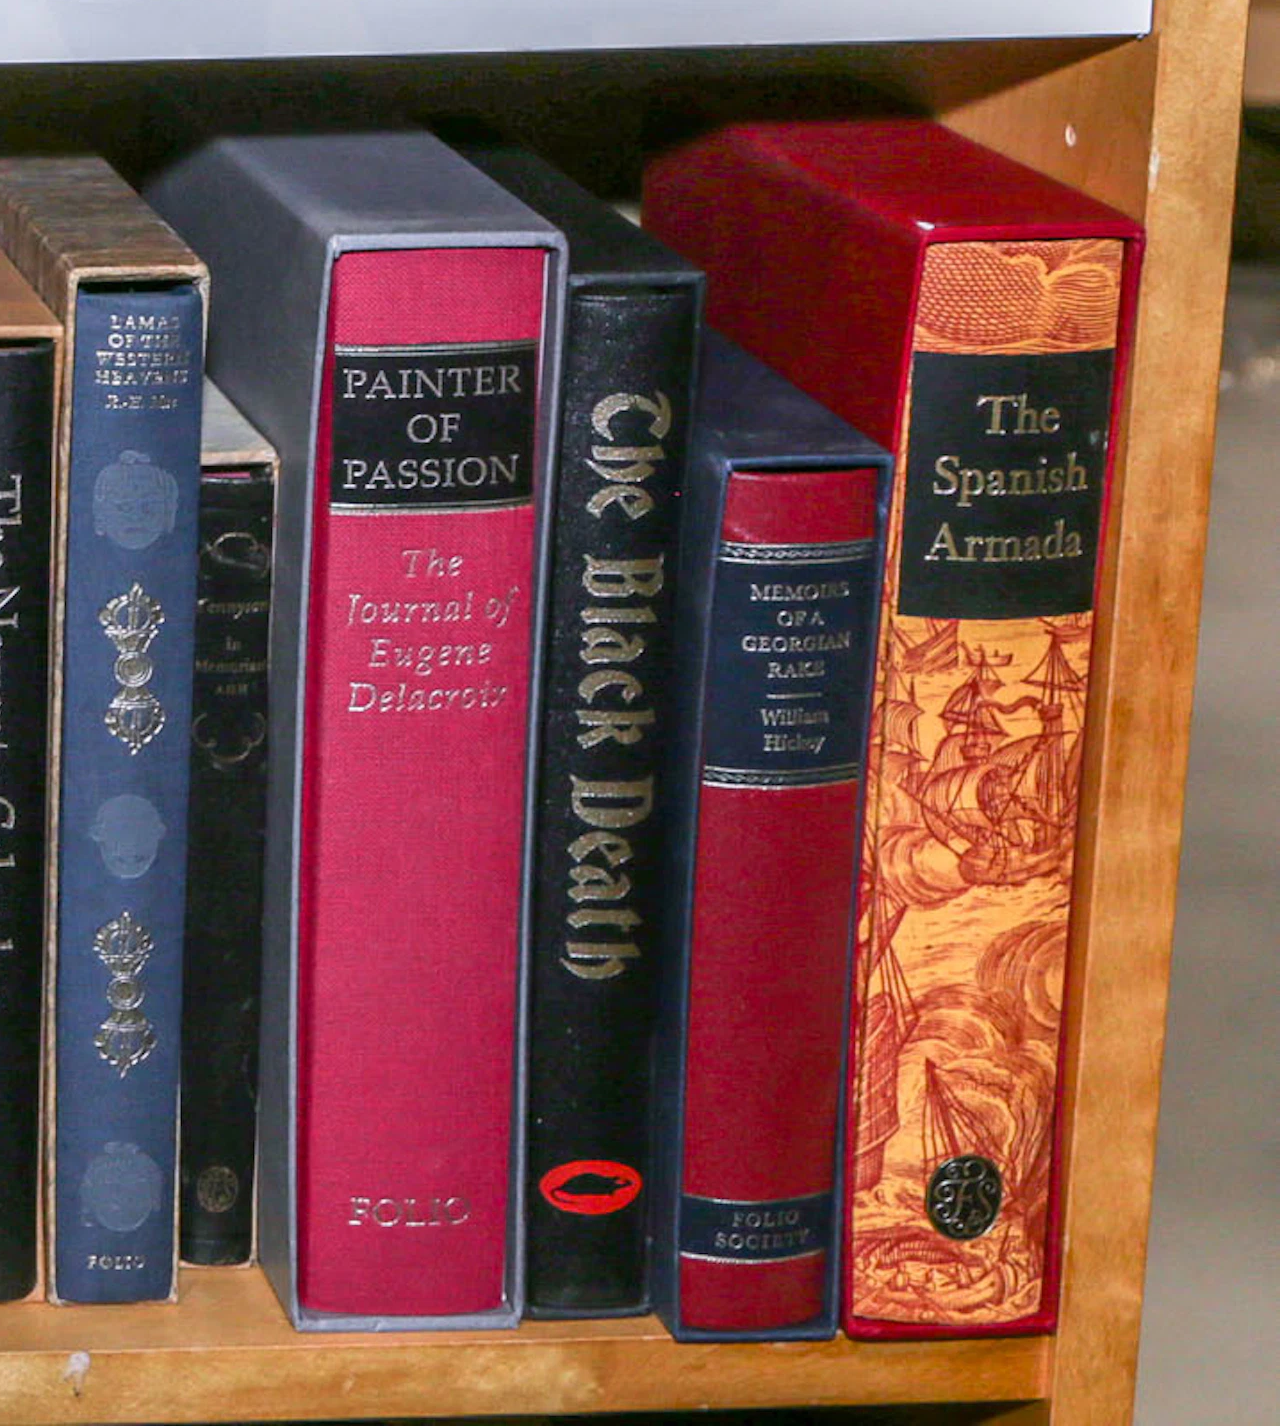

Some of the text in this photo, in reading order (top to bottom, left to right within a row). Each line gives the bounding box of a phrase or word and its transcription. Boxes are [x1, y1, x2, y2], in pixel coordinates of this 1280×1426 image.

[343, 365, 521, 399] PAINTER
[406, 413, 461, 443] OF
[977, 394, 1061, 435] The
[343, 454, 519, 489] PASSION
[933, 452, 1088, 506] Spanish
[925, 519, 1082, 562] Armada
[403, 550, 464, 578] The
[347, 586, 519, 627] Journal of
[750, 583, 849, 601] MEMOIRS
[776, 611, 807, 627] OF
[369, 639, 493, 676] Eugene
[576, 553, 666, 750] Black
[742, 632, 851, 653] GEORGIAN
[768, 661, 825, 679] RAKE
[348, 683, 508, 712] Delacroix
[561, 773, 656, 981] Death
[349, 1197, 472, 1227] FOLIO
